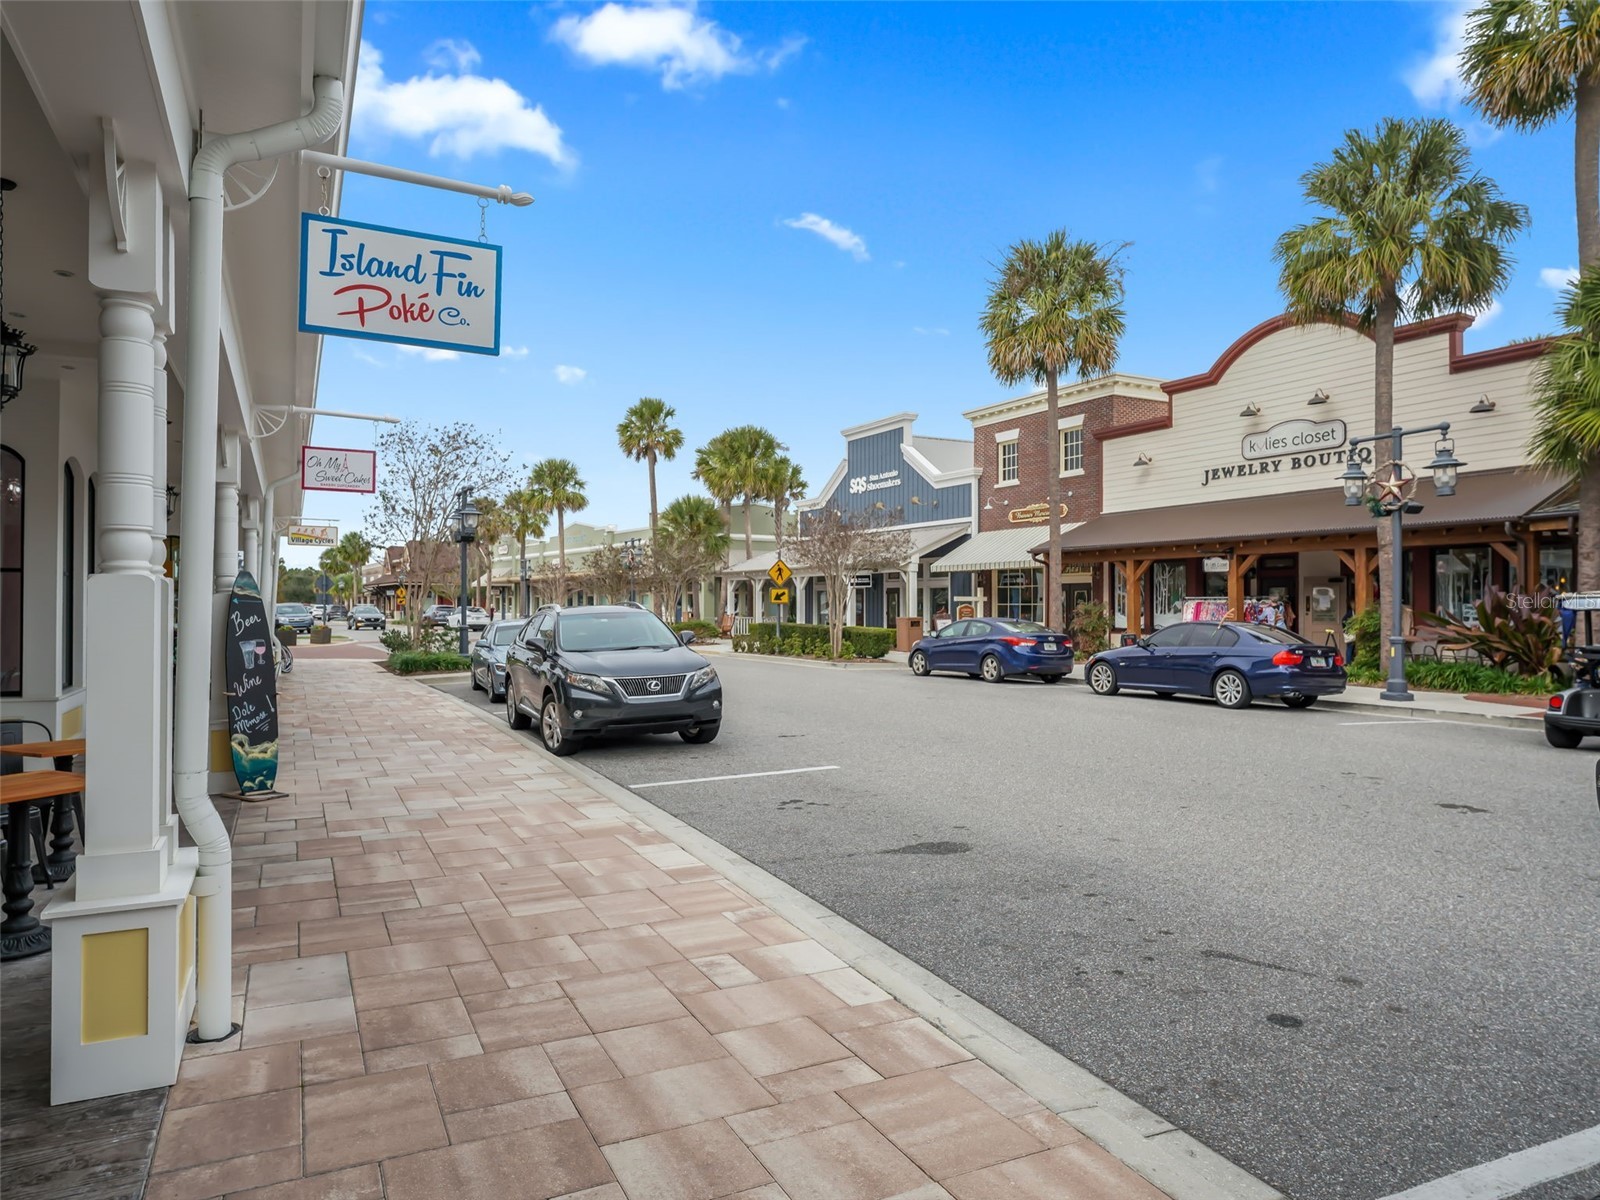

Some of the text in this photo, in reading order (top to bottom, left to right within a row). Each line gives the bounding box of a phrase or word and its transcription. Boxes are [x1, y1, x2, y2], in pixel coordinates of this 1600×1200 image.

[319, 228, 486, 298] Island Fin
[333, 284, 471, 327] Poké Co.
[1291, 427, 1337, 446] closet
[306, 455, 341, 473] Oh My
[1201, 446, 1373, 487] JEWELRY BOUTIQ
[314, 469, 371, 485] Sweet Cakes
[849, 476, 867, 495] SAS
[291, 537, 334, 545] Village Cycles
[230, 610, 262, 637] Beer
[233, 672, 262, 697] Wine
[232, 701, 256, 721] Dole
